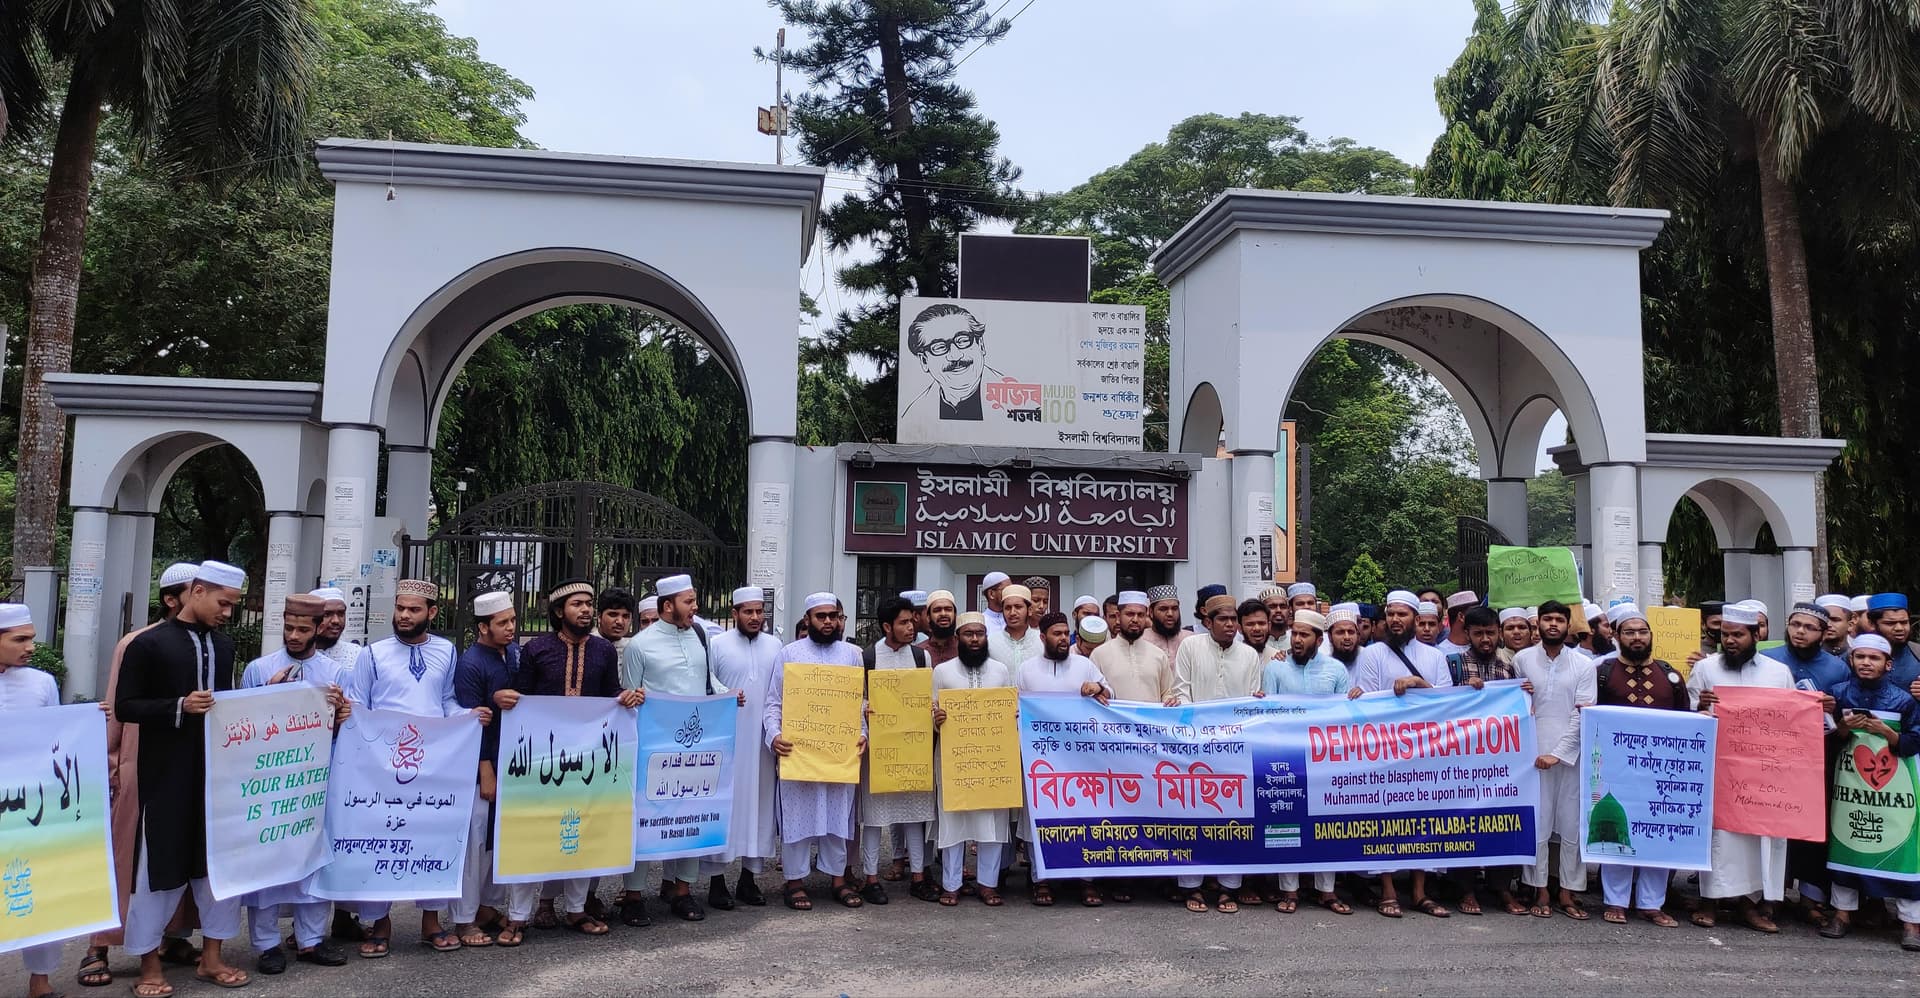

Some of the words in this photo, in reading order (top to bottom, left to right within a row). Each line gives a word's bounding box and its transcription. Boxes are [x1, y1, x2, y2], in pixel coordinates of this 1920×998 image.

[1129, 327, 1140, 336] নাম
[1043, 384, 1076, 399] MUJIB
[1007, 407, 1041, 422] শতবর্ষ
[1043, 399, 1076, 424] 100
[1057, 431, 1090, 444] ইসলামী
[1092, 432, 1141, 446] বিশ্ববিদ্যালয়
[917, 467, 1011, 497] ইসলামী
[1028, 472, 1178, 504] বিশ্ববিদ্যালয়
[1058, 501, 1176, 532] الجامعة
[915, 530, 1017, 551] ISLAMIC
[1031, 534, 1178, 555] UNIVERSITY
[1031, 721, 1062, 734] ভারতে
[1065, 718, 1098, 734] মহানবী
[1102, 722, 1132, 735] হযরত
[1200, 724, 1216, 736] এর
[1219, 722, 1243, 735] শানে
[1064, 741, 1072, 752] ও
[1075, 741, 1095, 753] চরম
[1098, 741, 1158, 754] অবমাননাকর
[1202, 739, 1245, 755] প্রতিবাদে
[1308, 715, 1521, 763] DEMONSTRATION
[1650, 736, 1688, 754] অপমানে
[1689, 732, 1706, 753] যদি
[255, 743, 316, 770] SURELY,
[508, 725, 532, 778] الله
[539, 729, 595, 786] رسول
[661, 751, 681, 769] فداء
[684, 754, 698, 767] لك
[700, 753, 716, 767] كلنا
[1627, 755, 1637, 769] না
[1639, 751, 1662, 774] কাঁদে
[1664, 758, 1686, 774] তোর
[1265, 772, 1296, 786] ইসলামী
[1331, 770, 1367, 787] against
[1369, 769, 1385, 784] the
[1387, 767, 1439, 786] blasphemy
[1441, 766, 1452, 780] of
[1453, 766, 1469, 780] the
[1470, 764, 1510, 784] prophet
[240, 775, 281, 798] YOUR
[656, 779, 668, 796] الله
[672, 780, 699, 797] رسول
[702, 780, 710, 795] يا
[1028, 759, 1144, 810] বিক্ষোভ
[1152, 760, 1248, 814] মিছিল
[1324, 789, 1380, 806] Muhammad
[1382, 791, 1415, 806] (peace
[1417, 789, 1430, 802] be
[1431, 788, 1456, 804] upon
[1457, 785, 1480, 802] him)
[1482, 785, 1492, 799] in
[1494, 784, 1519, 798] india
[1656, 774, 1688, 796] মুসলিম
[1689, 782, 1704, 797] নয়
[1731, 780, 1748, 791] We
[247, 803, 262, 822] IS
[271, 796, 299, 817] THE
[301, 790, 326, 810] ONE
[344, 791, 381, 809] الرسول
[384, 795, 404, 810] حب
[406, 791, 423, 811] في
[425, 793, 456, 810] الموت
[1648, 795, 1686, 818] মুনাফিক
[1687, 801, 1703, 819] তুই
[386, 815, 407, 832] عزة
[640, 818, 648, 828] We
[650, 815, 674, 827] sacrifice
[675, 814, 700, 825] ourselves
[700, 812, 709, 822] for
[1314, 820, 1378, 840] BANGLADESH
[1380, 818, 1427, 837] JAMIAT-E
[1428, 816, 1477, 836] TALABA-E
[1478, 814, 1522, 833] ARABIYA
[259, 822, 290, 844] CUT
[291, 816, 315, 838] OFF.
[1090, 819, 1139, 843] জমিয়তে
[1142, 822, 1199, 843] তালাবায়ে
[1202, 819, 1255, 842] আরাবিয়া
[1081, 846, 1116, 865] ইসলামী
[1118, 847, 1169, 864] বিশ্ববিদ্যালয়
[1171, 848, 1192, 863] শাখা
[1363, 843, 1395, 855] ISLAMIC
[1396, 842, 1443, 855] UNIVERSITY
[1444, 841, 1476, 853] BRANCH
[375, 859, 389, 875] সে
